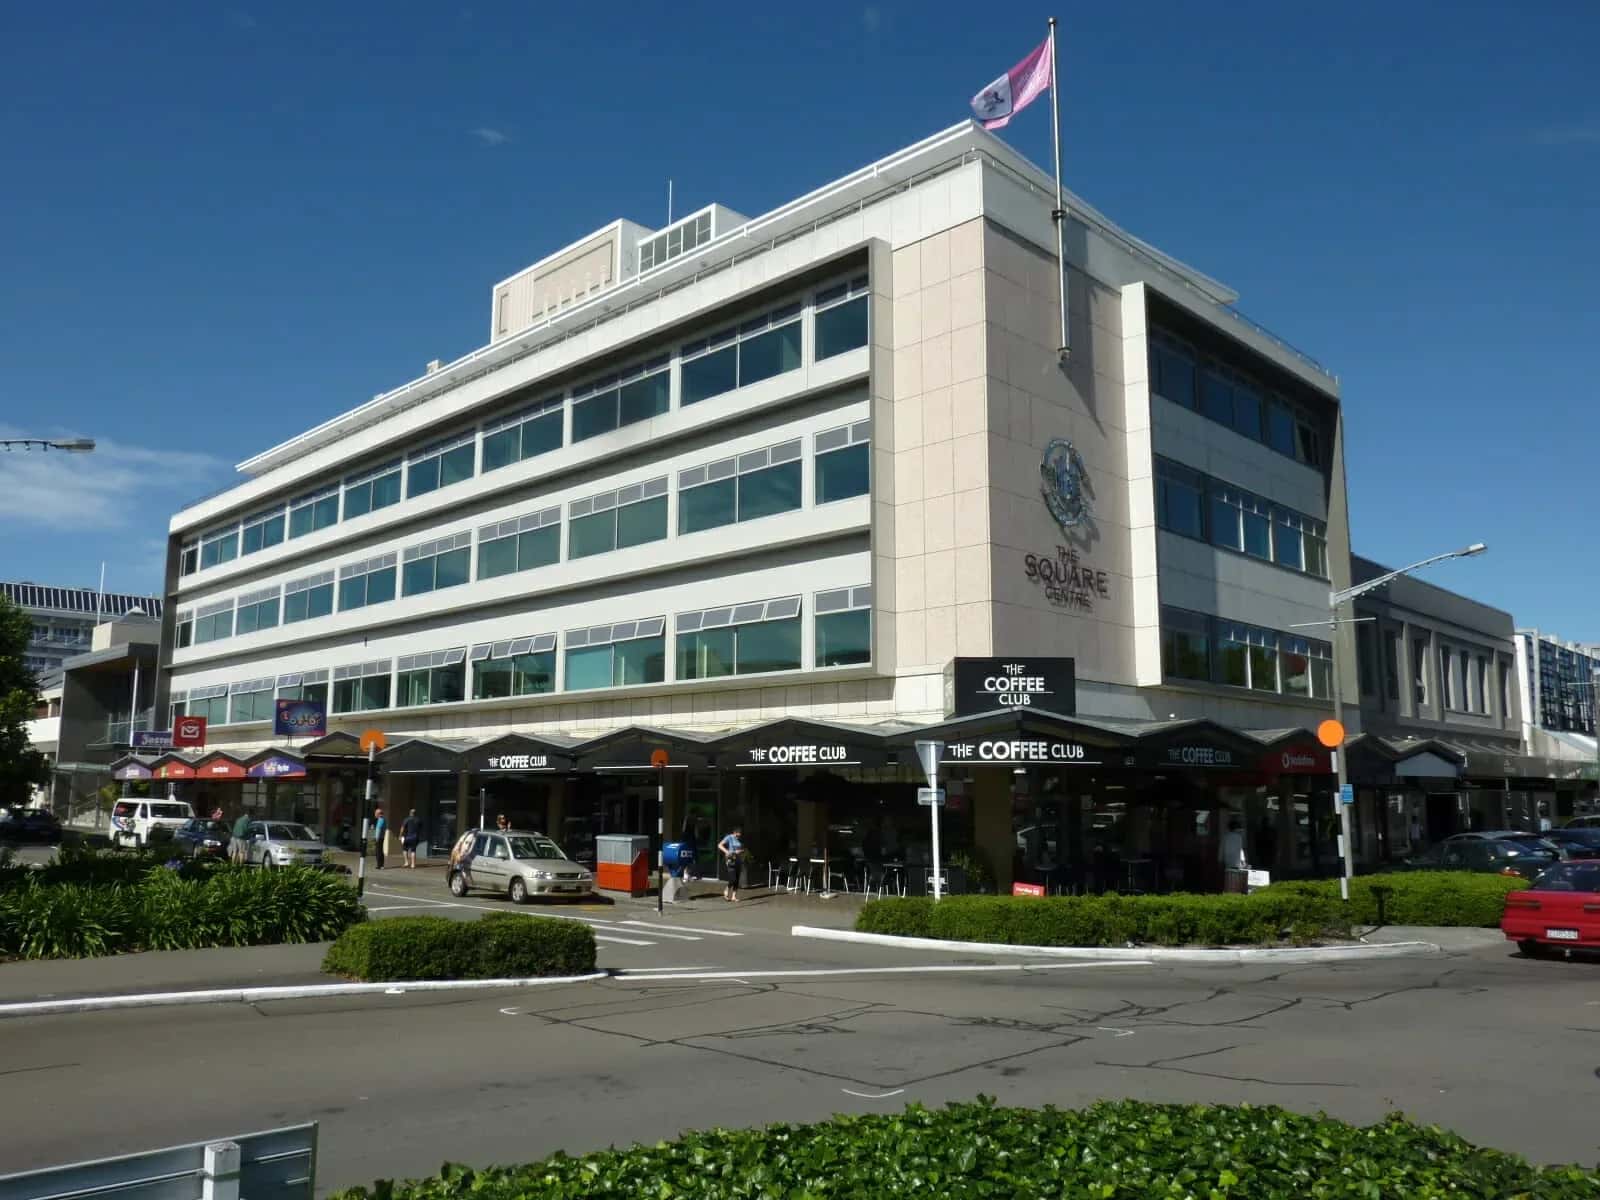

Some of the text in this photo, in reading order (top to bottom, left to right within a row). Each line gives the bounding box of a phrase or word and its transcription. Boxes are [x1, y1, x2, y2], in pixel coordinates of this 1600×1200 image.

[1056, 545, 1080, 562] THE
[1025, 554, 1107, 593] SQUARE
[1045, 586, 1091, 607] CENTRE
[1002, 664, 1026, 676] THE
[984, 677, 1044, 692] COFFEE
[999, 694, 1031, 705] CLUB
[749, 745, 847, 762] THE COFFEE CLUB
[947, 741, 1084, 760] THE COFFEE CLUB
[1168, 747, 1232, 763] THE COFFEE CLUB
[488, 755, 547, 768] THE COFFEE CLUB
